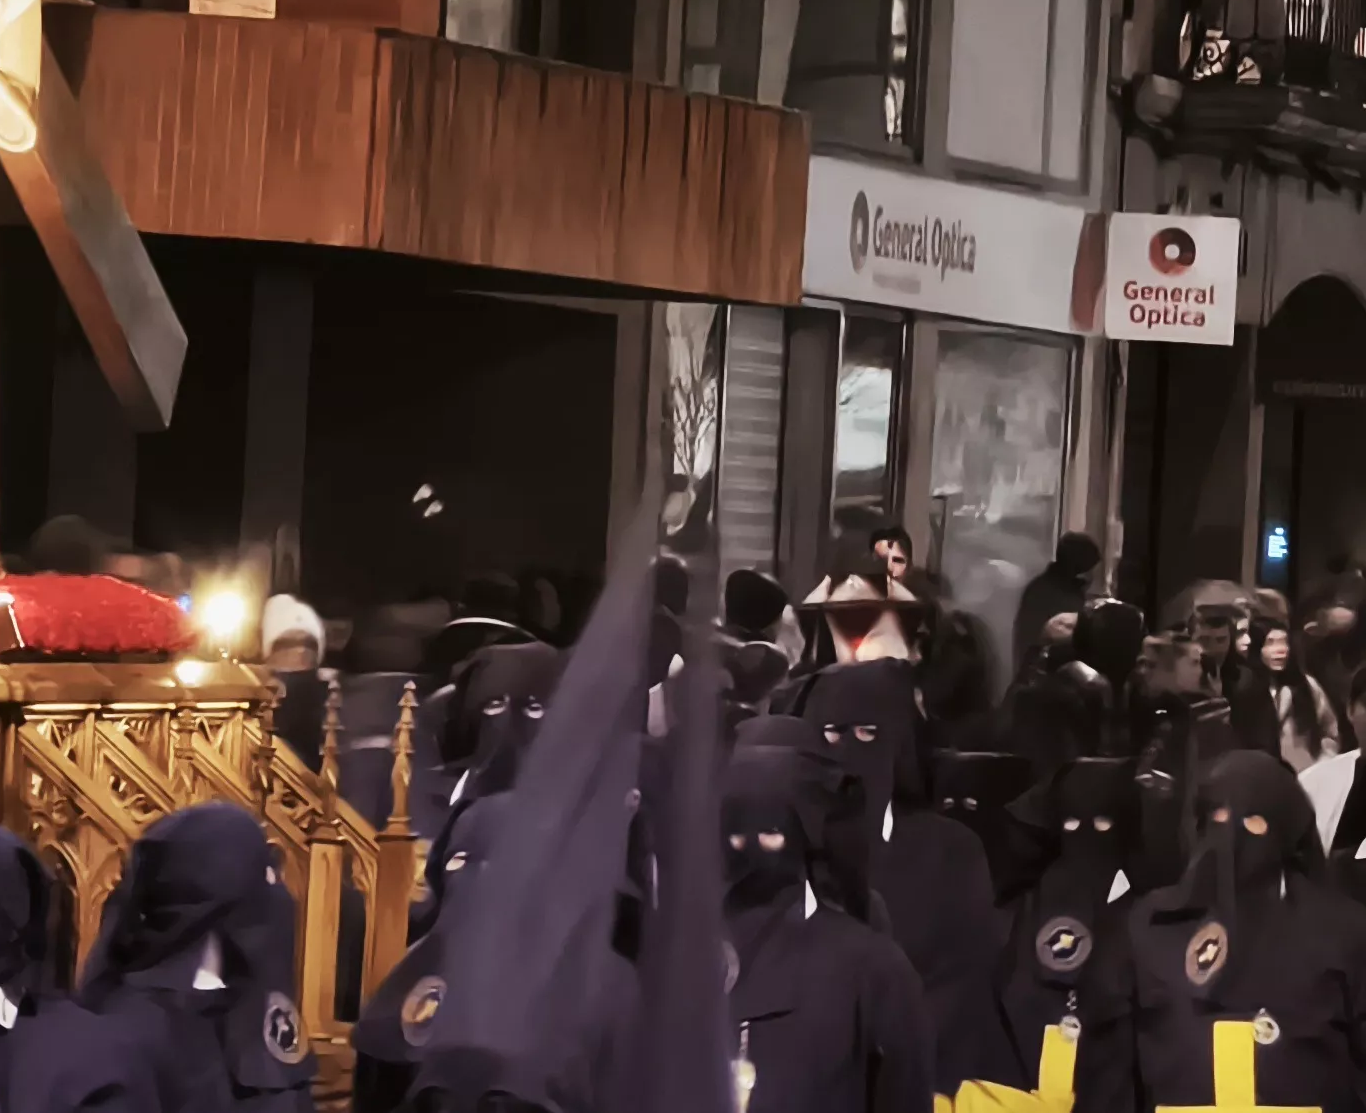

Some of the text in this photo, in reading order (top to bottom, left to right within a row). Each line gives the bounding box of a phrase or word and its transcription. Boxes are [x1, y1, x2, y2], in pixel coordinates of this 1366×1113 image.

[873, 205, 929, 266] General
[1123, 280, 1215, 305] General
[1129, 303, 1206, 329] Optica
